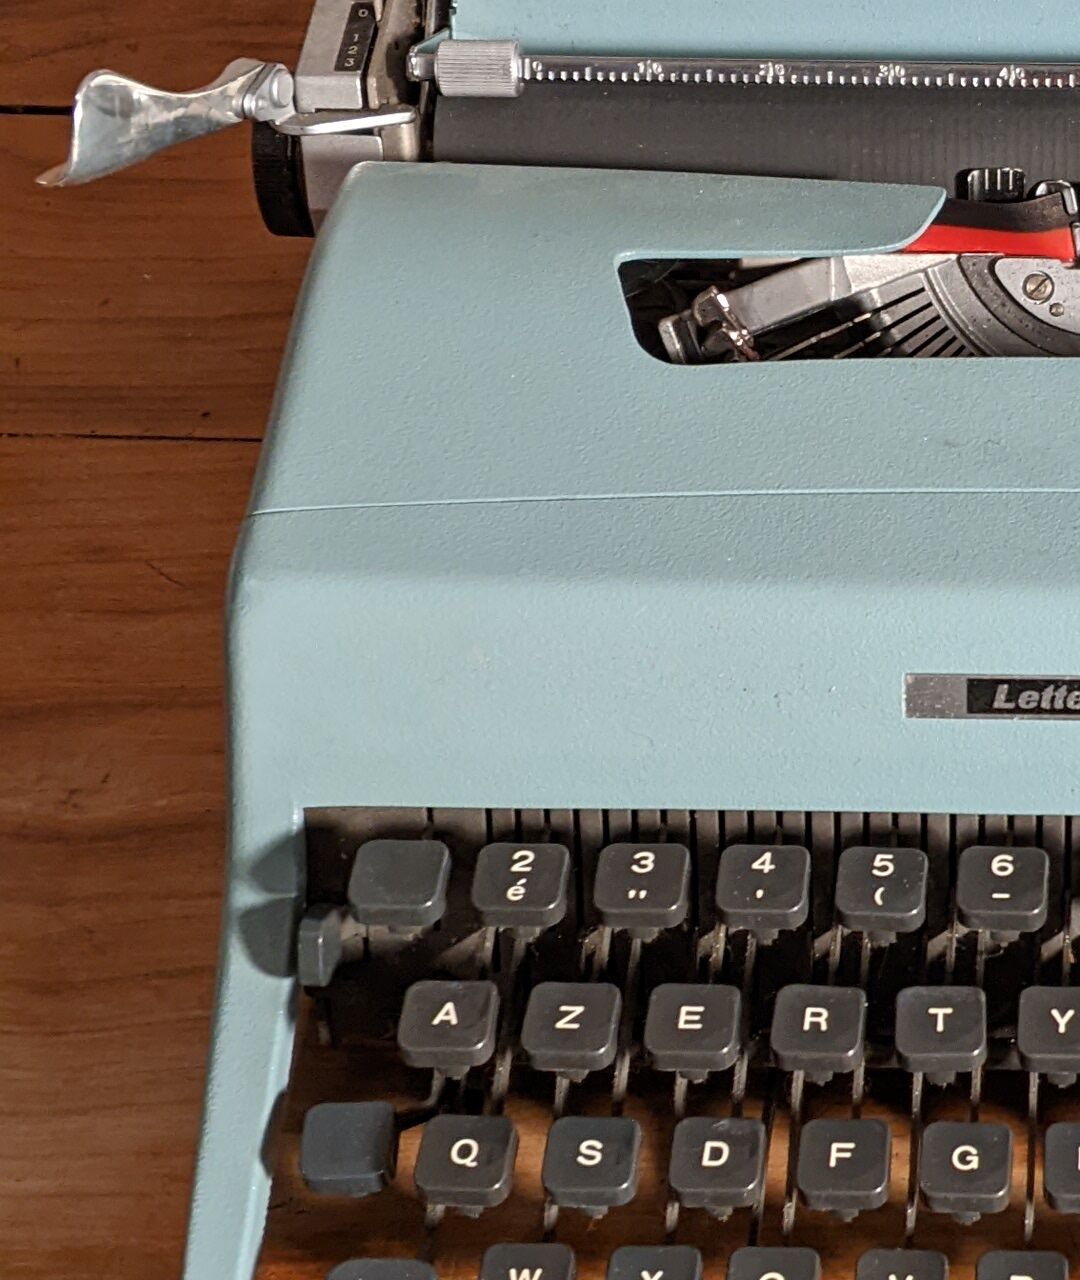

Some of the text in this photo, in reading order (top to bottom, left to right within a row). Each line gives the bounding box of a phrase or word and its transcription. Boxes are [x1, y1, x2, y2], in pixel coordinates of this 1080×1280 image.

[510, 850, 535, 872] 2
[631, 851, 655, 874] 3
[751, 851, 776, 874] 4
[871, 853, 895, 877] 5
[990, 854, 1015, 876] 6
[506, 877, 527, 901] é
[873, 886, 885, 906] (
[432, 1001, 458, 1025] A
[555, 1005, 585, 1029] Z
[678, 1005, 705, 1029] E
[802, 1007, 829, 1031] R
[928, 1007, 954, 1032] T
[1049, 1008, 1076, 1034] Y
[450, 1138, 480, 1167] Q
[576, 1139, 603, 1166] S
[701, 1140, 731, 1167] D
[829, 1142, 856, 1168] F
[951, 1145, 980, 1171] G
